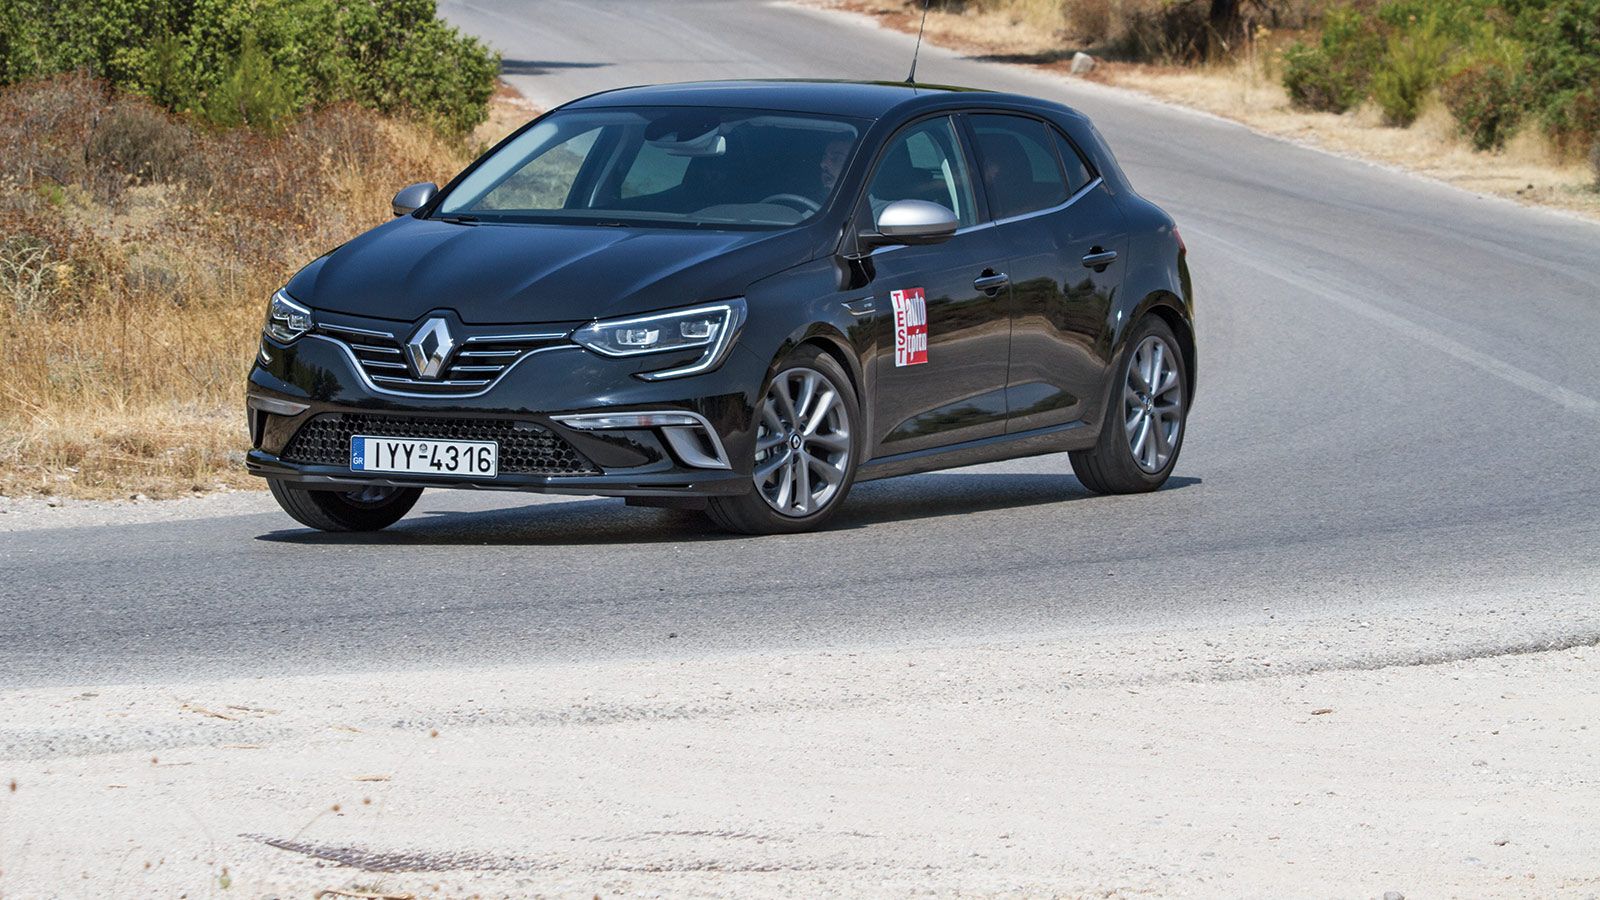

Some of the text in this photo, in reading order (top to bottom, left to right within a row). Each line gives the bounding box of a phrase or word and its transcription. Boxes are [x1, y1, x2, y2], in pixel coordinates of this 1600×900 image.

[906, 291, 926, 327] auto
[893, 293, 905, 363] TEST
[353, 456, 363, 465] GR
